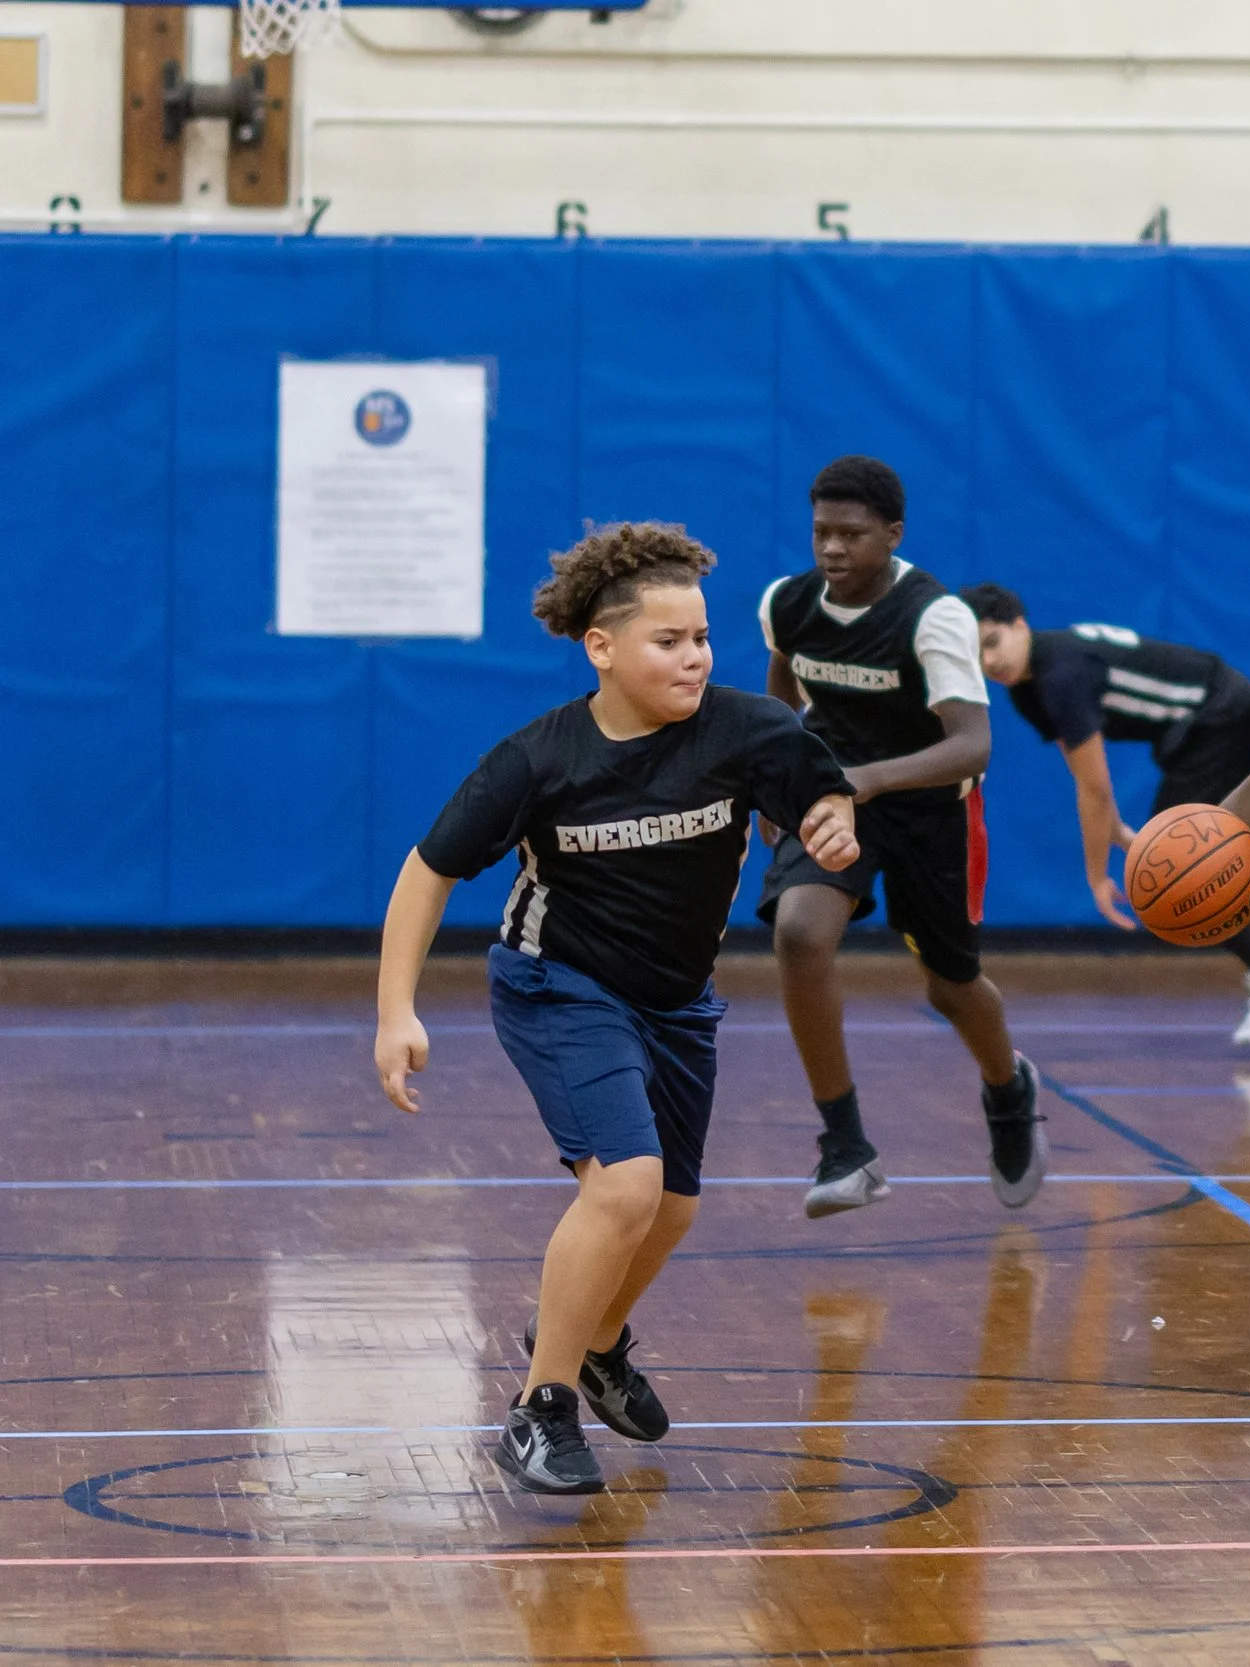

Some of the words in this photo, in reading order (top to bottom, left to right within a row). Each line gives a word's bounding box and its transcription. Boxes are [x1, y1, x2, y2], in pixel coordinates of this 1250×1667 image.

[817, 202, 850, 243] 5
[1138, 205, 1169, 246] 4
[791, 653, 900, 691] EVERGREEN
[555, 798, 735, 853] EVERGREEN
[1168, 814, 1224, 855] MS
[1138, 846, 1176, 892] 50
[1172, 856, 1245, 917] EVOLUTION
